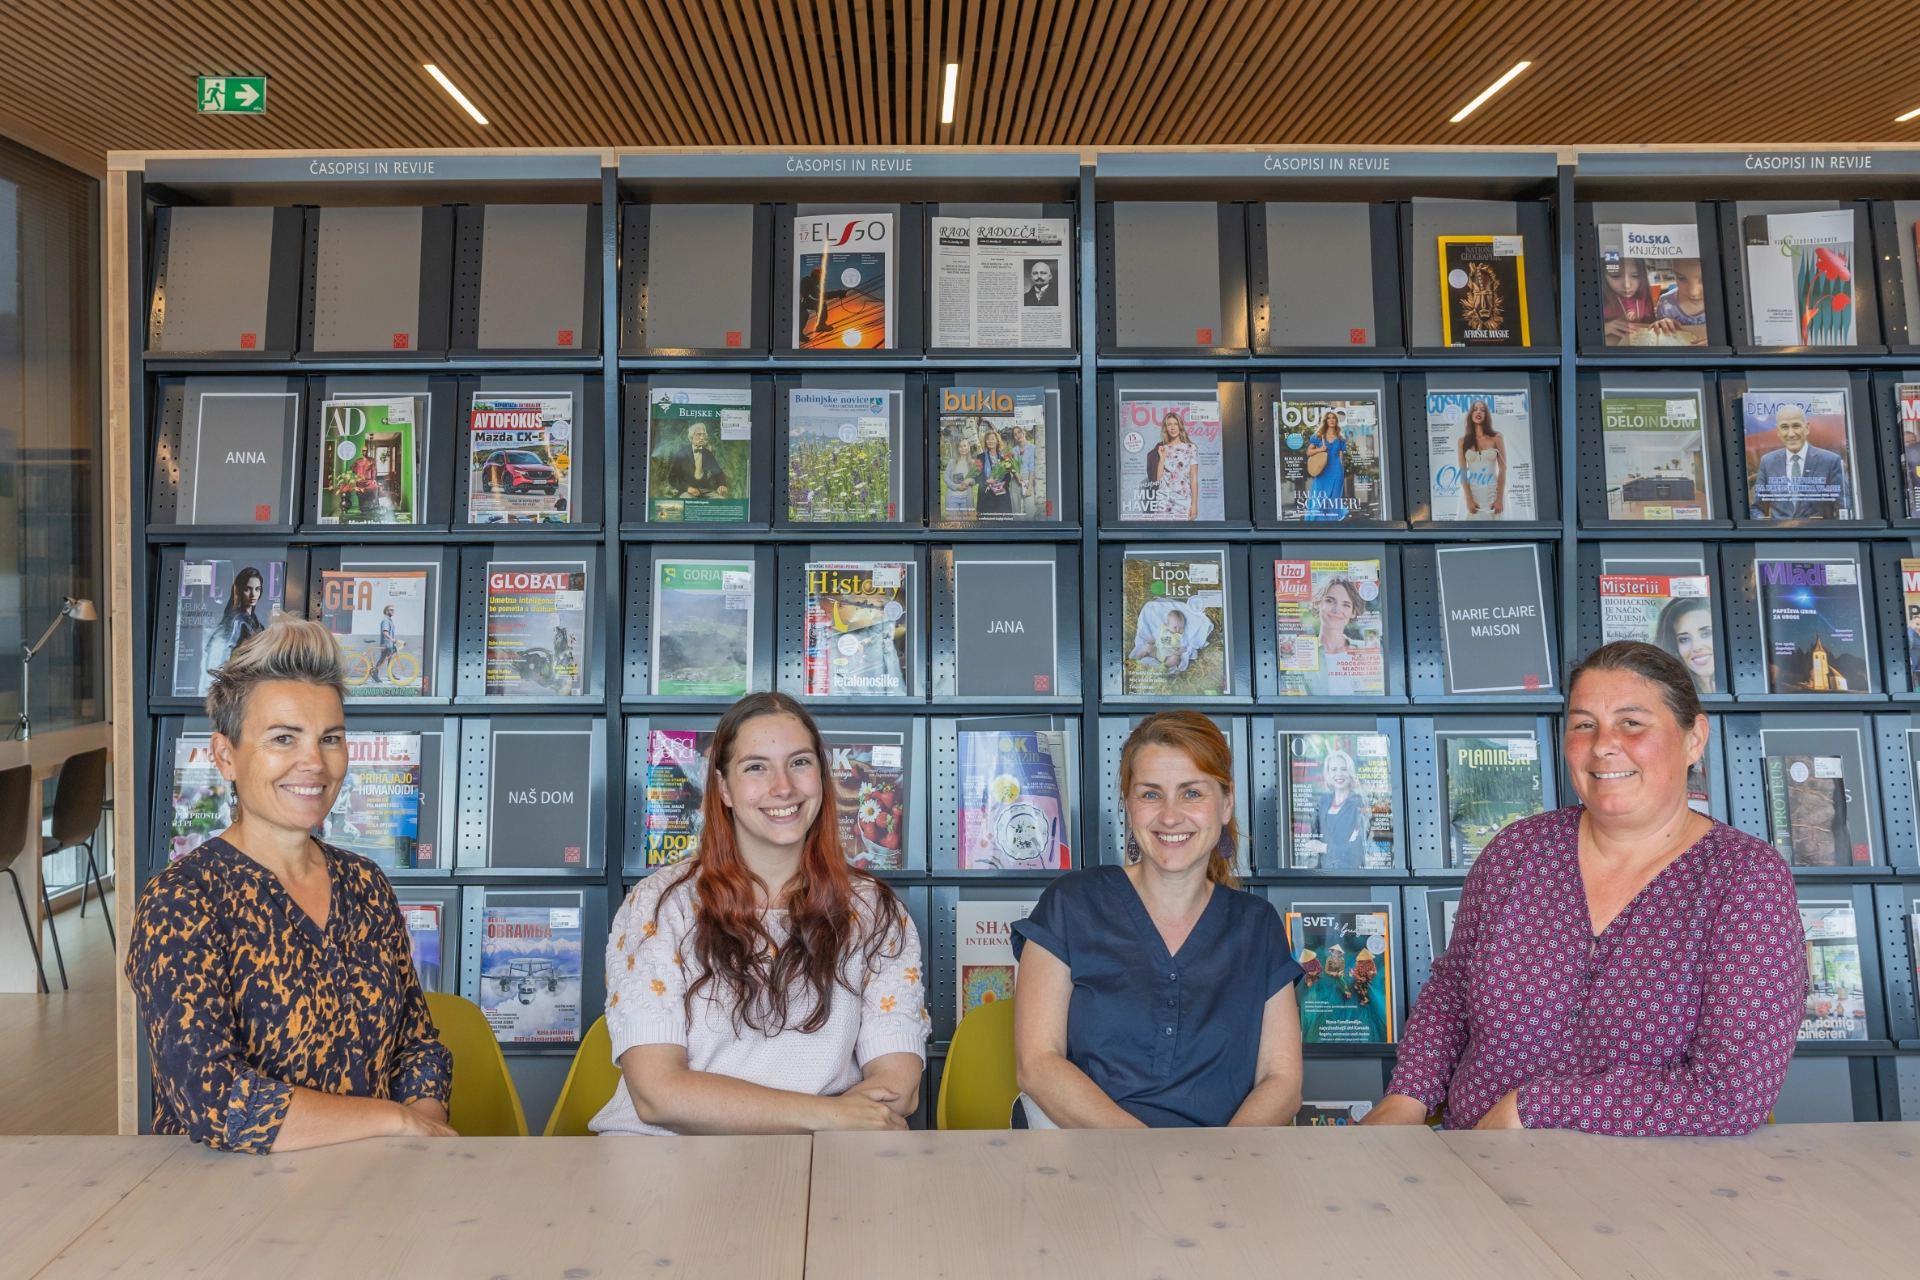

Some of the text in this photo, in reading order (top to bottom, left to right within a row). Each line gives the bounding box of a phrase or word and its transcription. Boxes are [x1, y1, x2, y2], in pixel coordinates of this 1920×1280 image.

[310, 159, 434, 175] ČASOPISI IN REVIJE
[786, 156, 912, 172] ČASOPISI IN REVIJE
[1264, 155, 1390, 170] ČASOPISI IN REVIJE
[1745, 154, 1871, 169] ČASOPISI IN REVIJE
[939, 226, 970, 238] RADO
[977, 225, 1037, 239] RADOLČA
[1628, 232, 1670, 244] ŠOLSKA
[1629, 245, 1683, 256] KNJIŽNICA
[795, 394, 869, 405] Bohinjske novice
[944, 389, 1015, 412] bukla
[326, 407, 366, 437] AD
[474, 412, 543, 429] AVTOFOKUS
[475, 432, 546, 442] Mazda CX-5
[1189, 427, 1221, 442] easy
[225, 452, 266, 464] ANNA
[1436, 463, 1494, 488] Olivia
[1122, 501, 1167, 512] HAVES
[1296, 498, 1362, 510] SOMMER!
[683, 569, 721, 581] GORJA
[1280, 565, 1301, 577] Liza
[1762, 562, 1840, 586] Mladi
[490, 573, 567, 590] GLOBAL
[1602, 581, 1659, 594] Misteriji
[325, 580, 373, 611] GEA
[1165, 582, 1191, 596] List
[1279, 581, 1307, 597] Maja
[489, 596, 517, 605] Umetna
[1451, 605, 1536, 621] MARIE CLAIRE
[1605, 605, 1641, 615] JE NAČIN
[1605, 613, 1647, 623] ŽIVLJENJA
[987, 620, 1025, 633] JANA
[1471, 624, 1520, 637] MAISON
[834, 674, 899, 687] letalonosilke
[189, 747, 216, 763] Mo
[359, 773, 412, 784] PRIHAJAJO
[1532, 775, 1539, 788] 5
[359, 784, 414, 795] HUMANOIDI
[508, 788, 574, 804] NAŠ DOM
[1769, 761, 1789, 828] PROTEUS
[975, 920, 1013, 935] SHA
[1303, 917, 1335, 927] SVET
[487, 923, 553, 939] OBRAMBA
[965, 937, 1012, 946] INTERNA
[1799, 1017, 1855, 1031] en richtig
